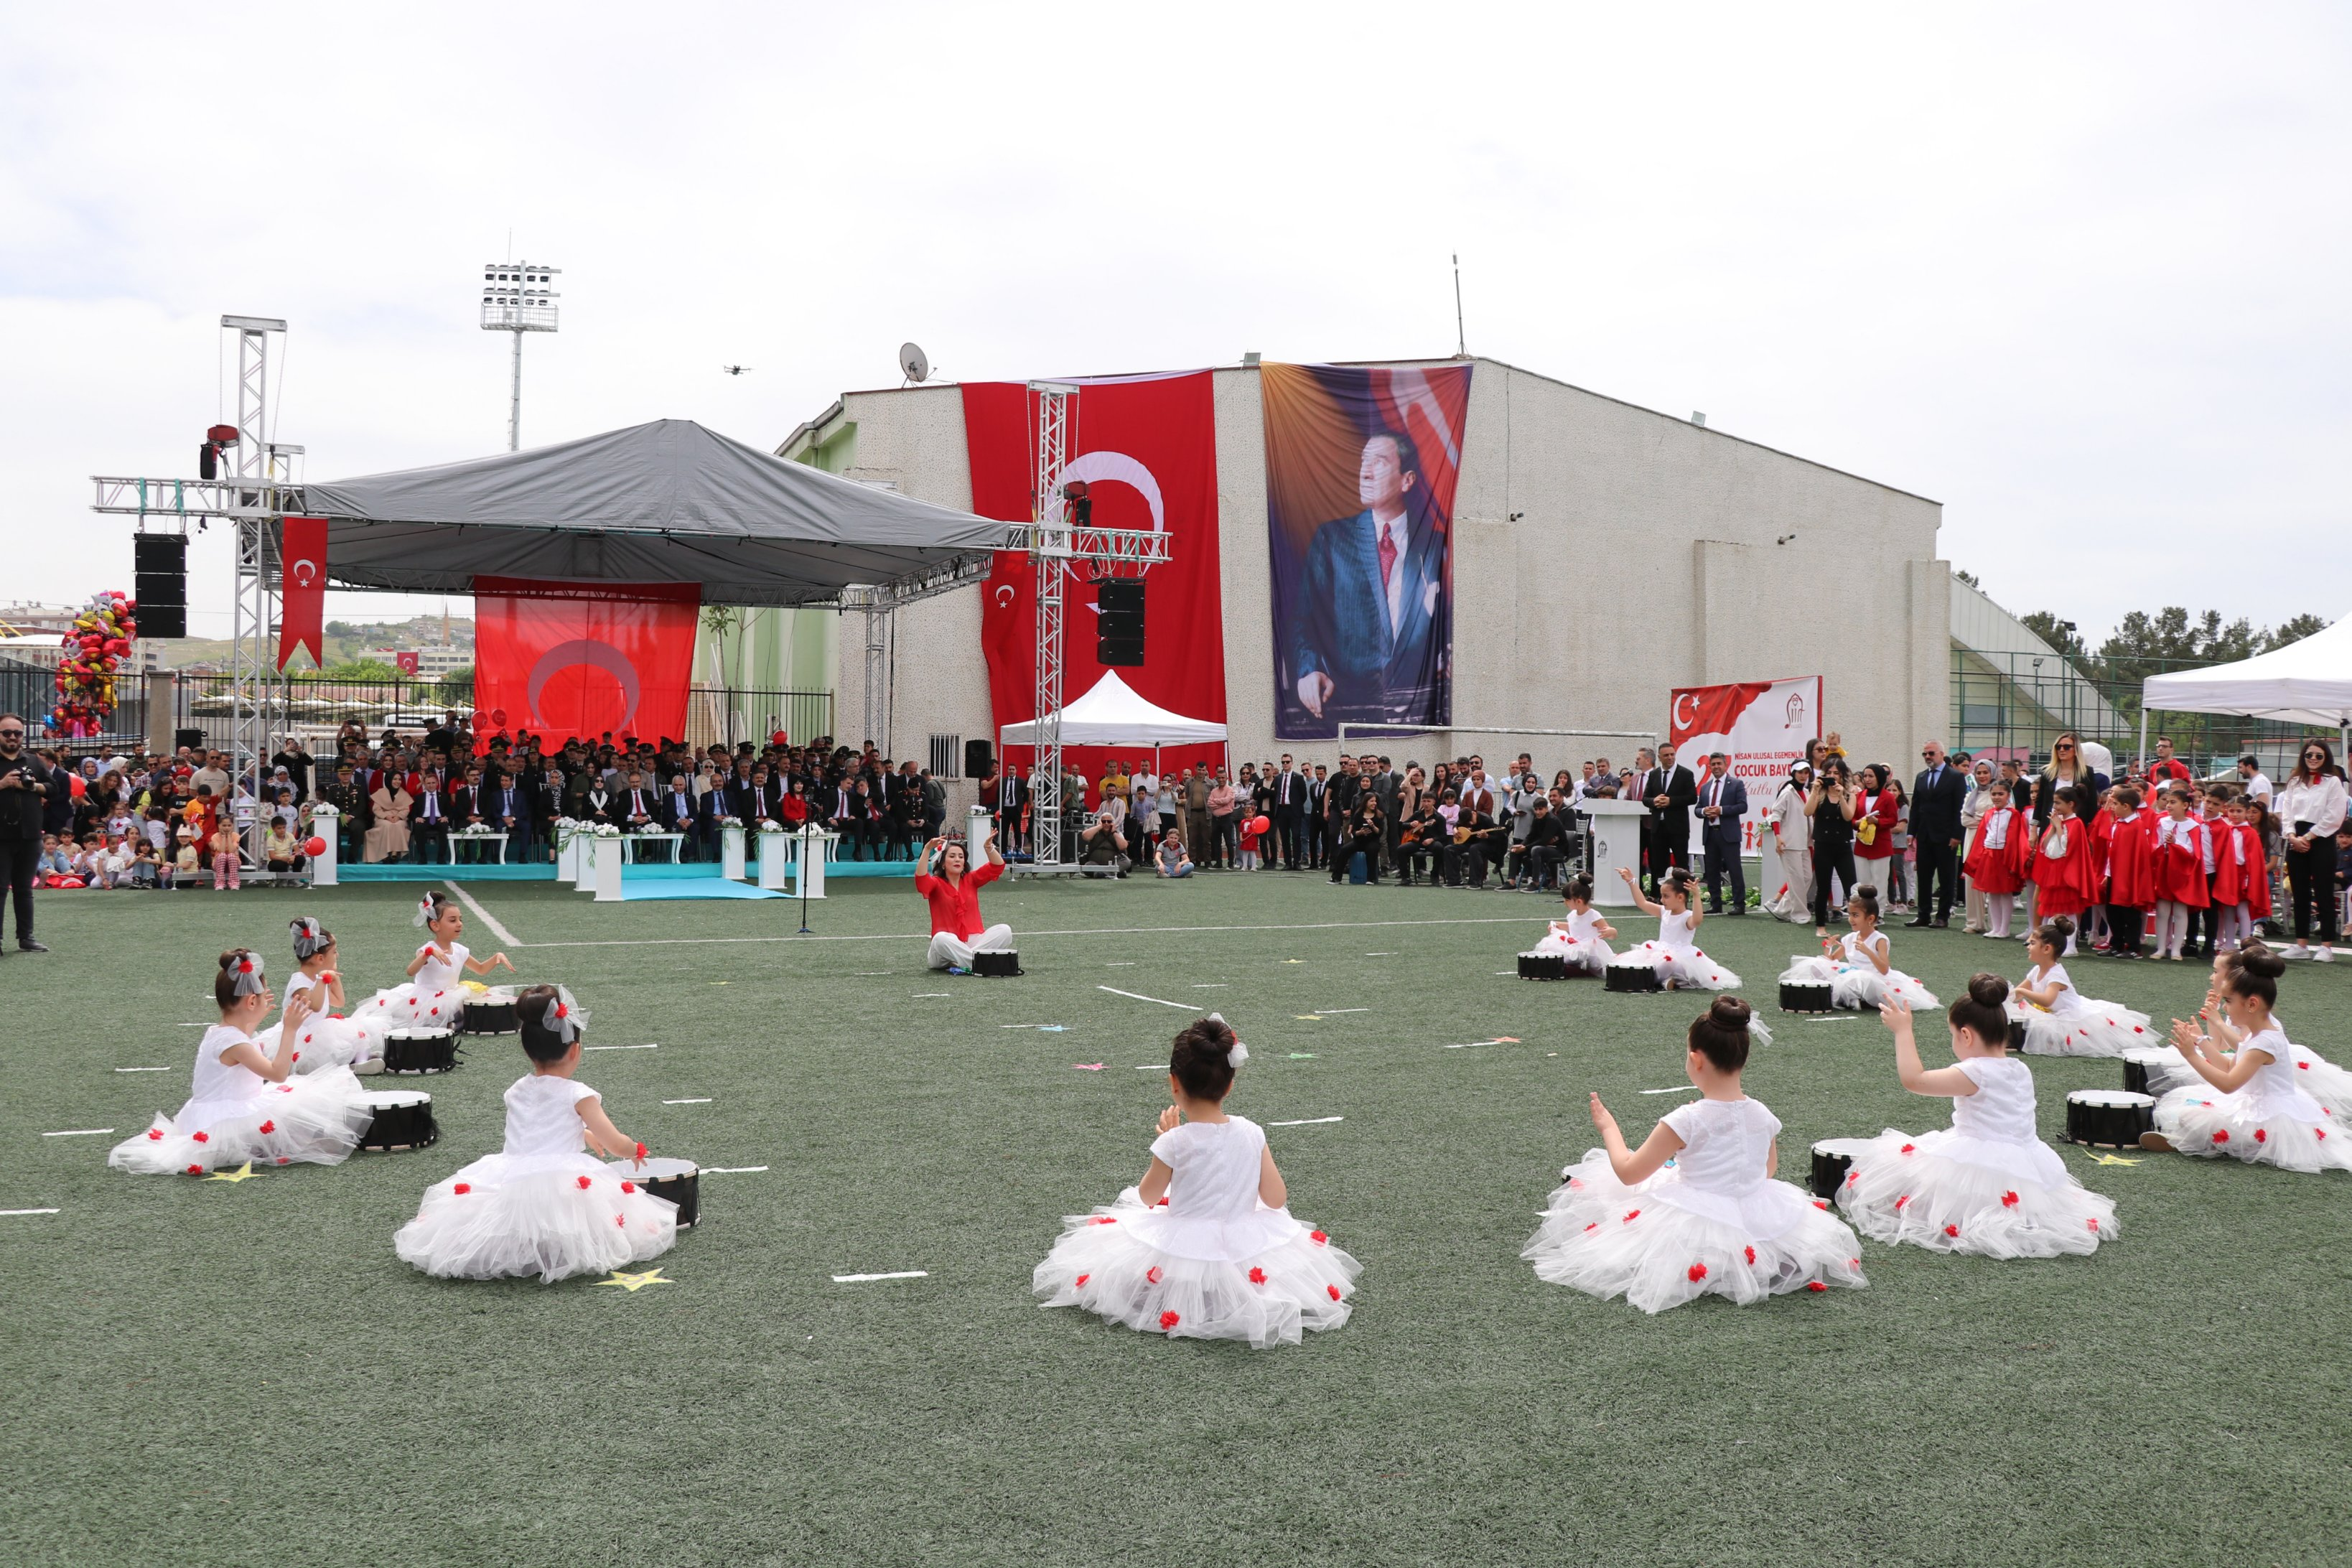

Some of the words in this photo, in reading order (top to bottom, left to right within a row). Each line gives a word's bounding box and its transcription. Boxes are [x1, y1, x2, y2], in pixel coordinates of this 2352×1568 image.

[1774, 750, 1804, 759] EGEMENLİK
[1697, 755, 1732, 796] 2
[1735, 764, 1767, 779] ÇOCUK
